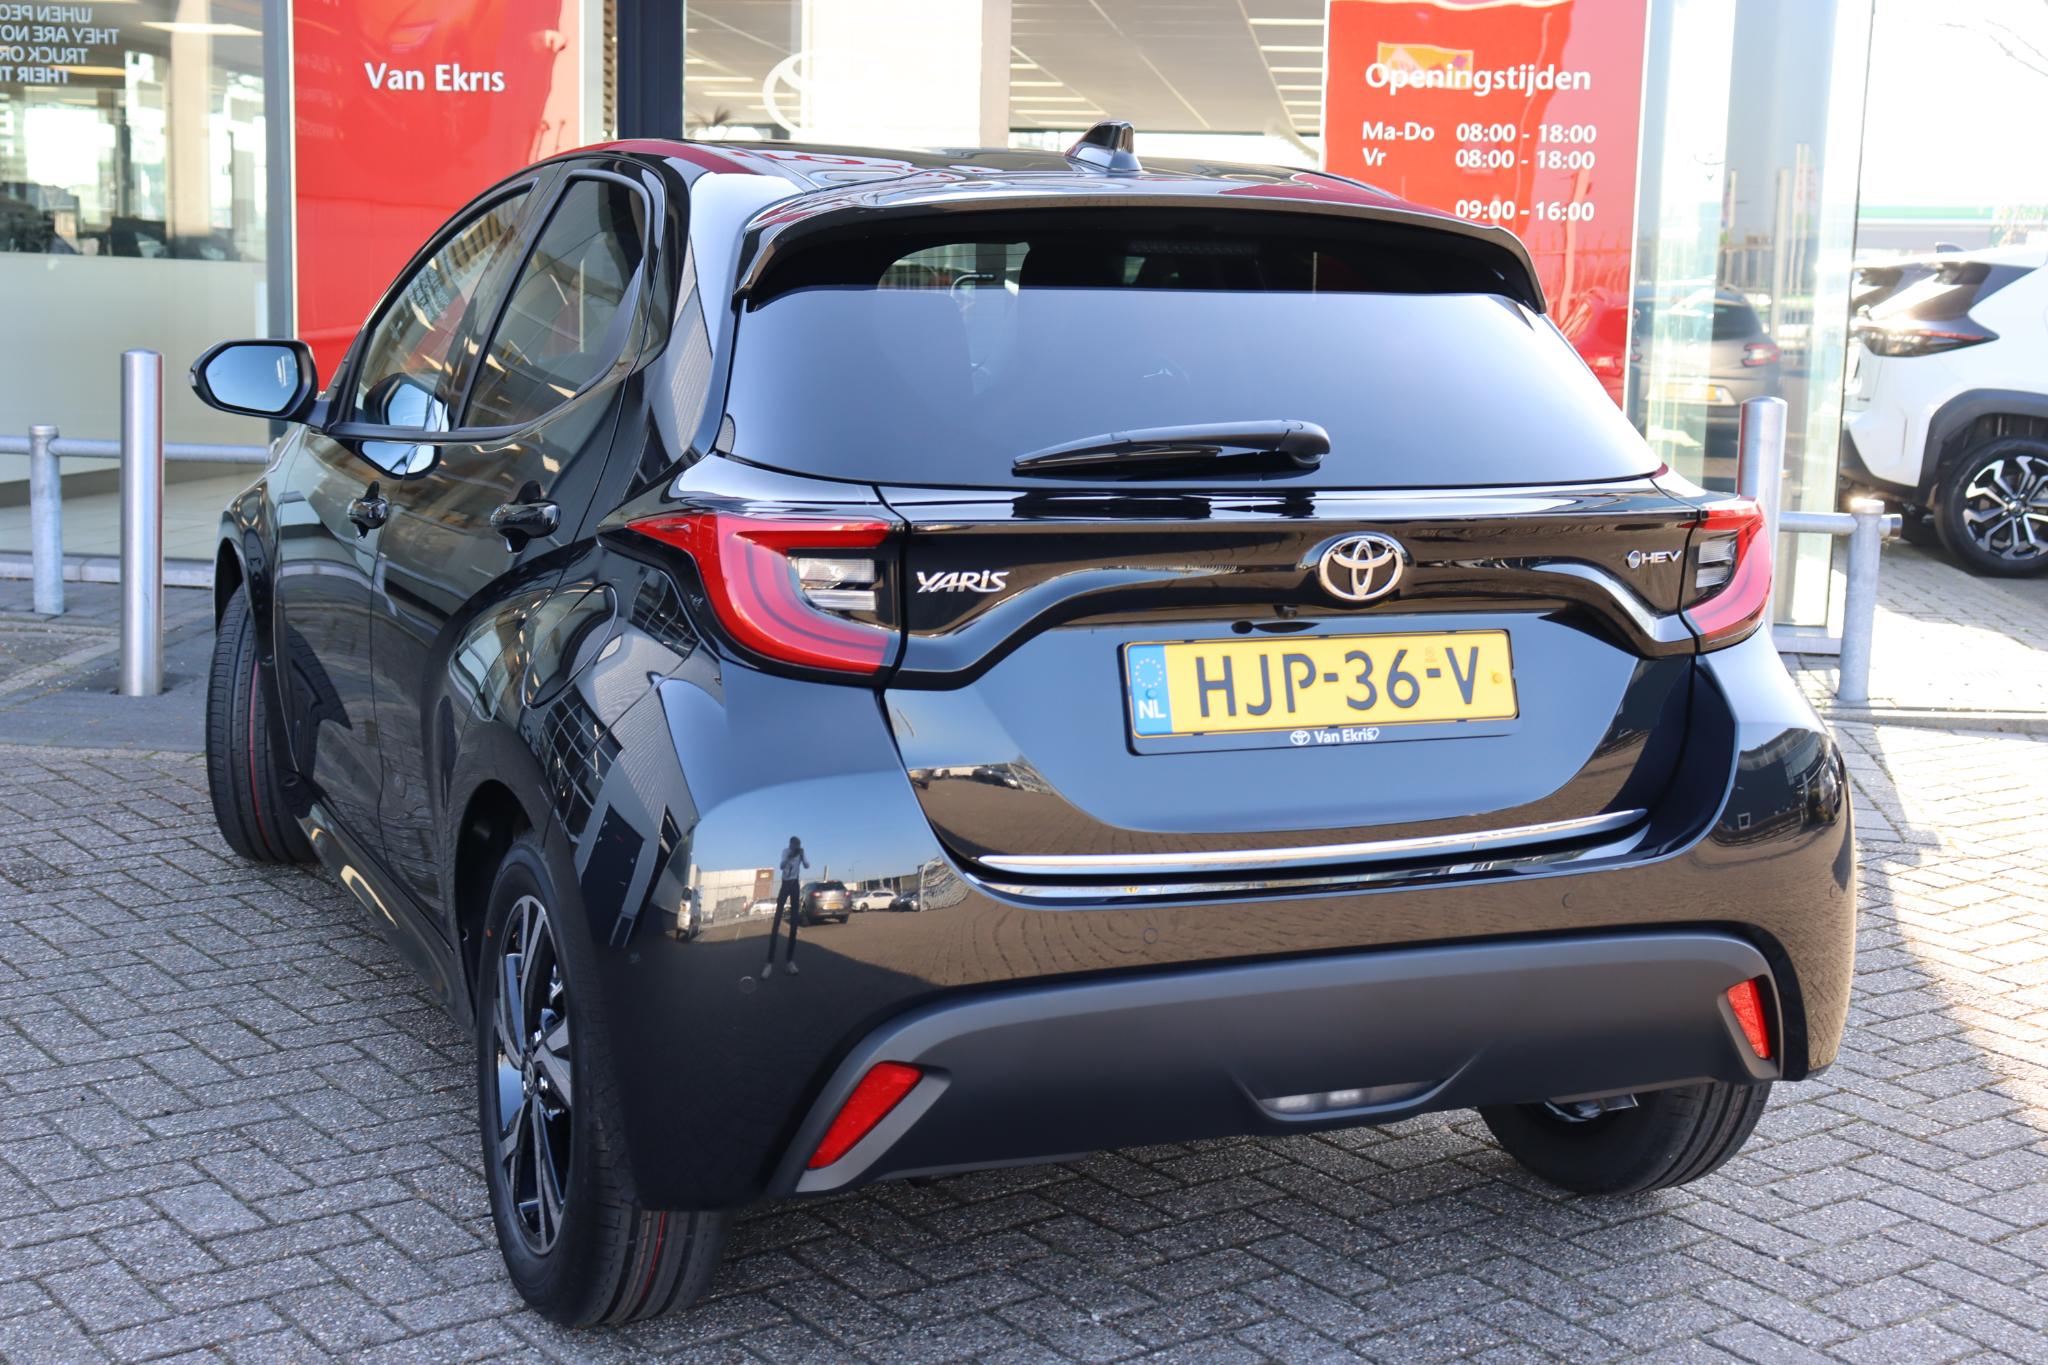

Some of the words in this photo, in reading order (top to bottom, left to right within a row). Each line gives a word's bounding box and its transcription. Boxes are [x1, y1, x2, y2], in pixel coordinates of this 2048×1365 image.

[364, 62, 425, 91] Van
[435, 63, 506, 92] Ekris
[1365, 63, 1592, 97] Openingstijden
[1362, 121, 1435, 141] Ma-Do
[1455, 123, 1517, 143] 08:00
[1538, 124, 1597, 144] 18:00
[1362, 148, 1387, 167] Vr
[1455, 149, 1515, 169] 08:00
[1537, 150, 1596, 170] 18:00
[1455, 199, 1515, 220] 09:00
[1535, 201, 1595, 222] 16:00
[1641, 550, 1682, 564] HEV
[916, 570, 1010, 593] YARIS
[1194, 645, 1480, 718] HJP-36-V
[1138, 699, 1167, 720] NL
[1313, 730, 1340, 744] Van
[1341, 727, 1375, 743] Ekris
